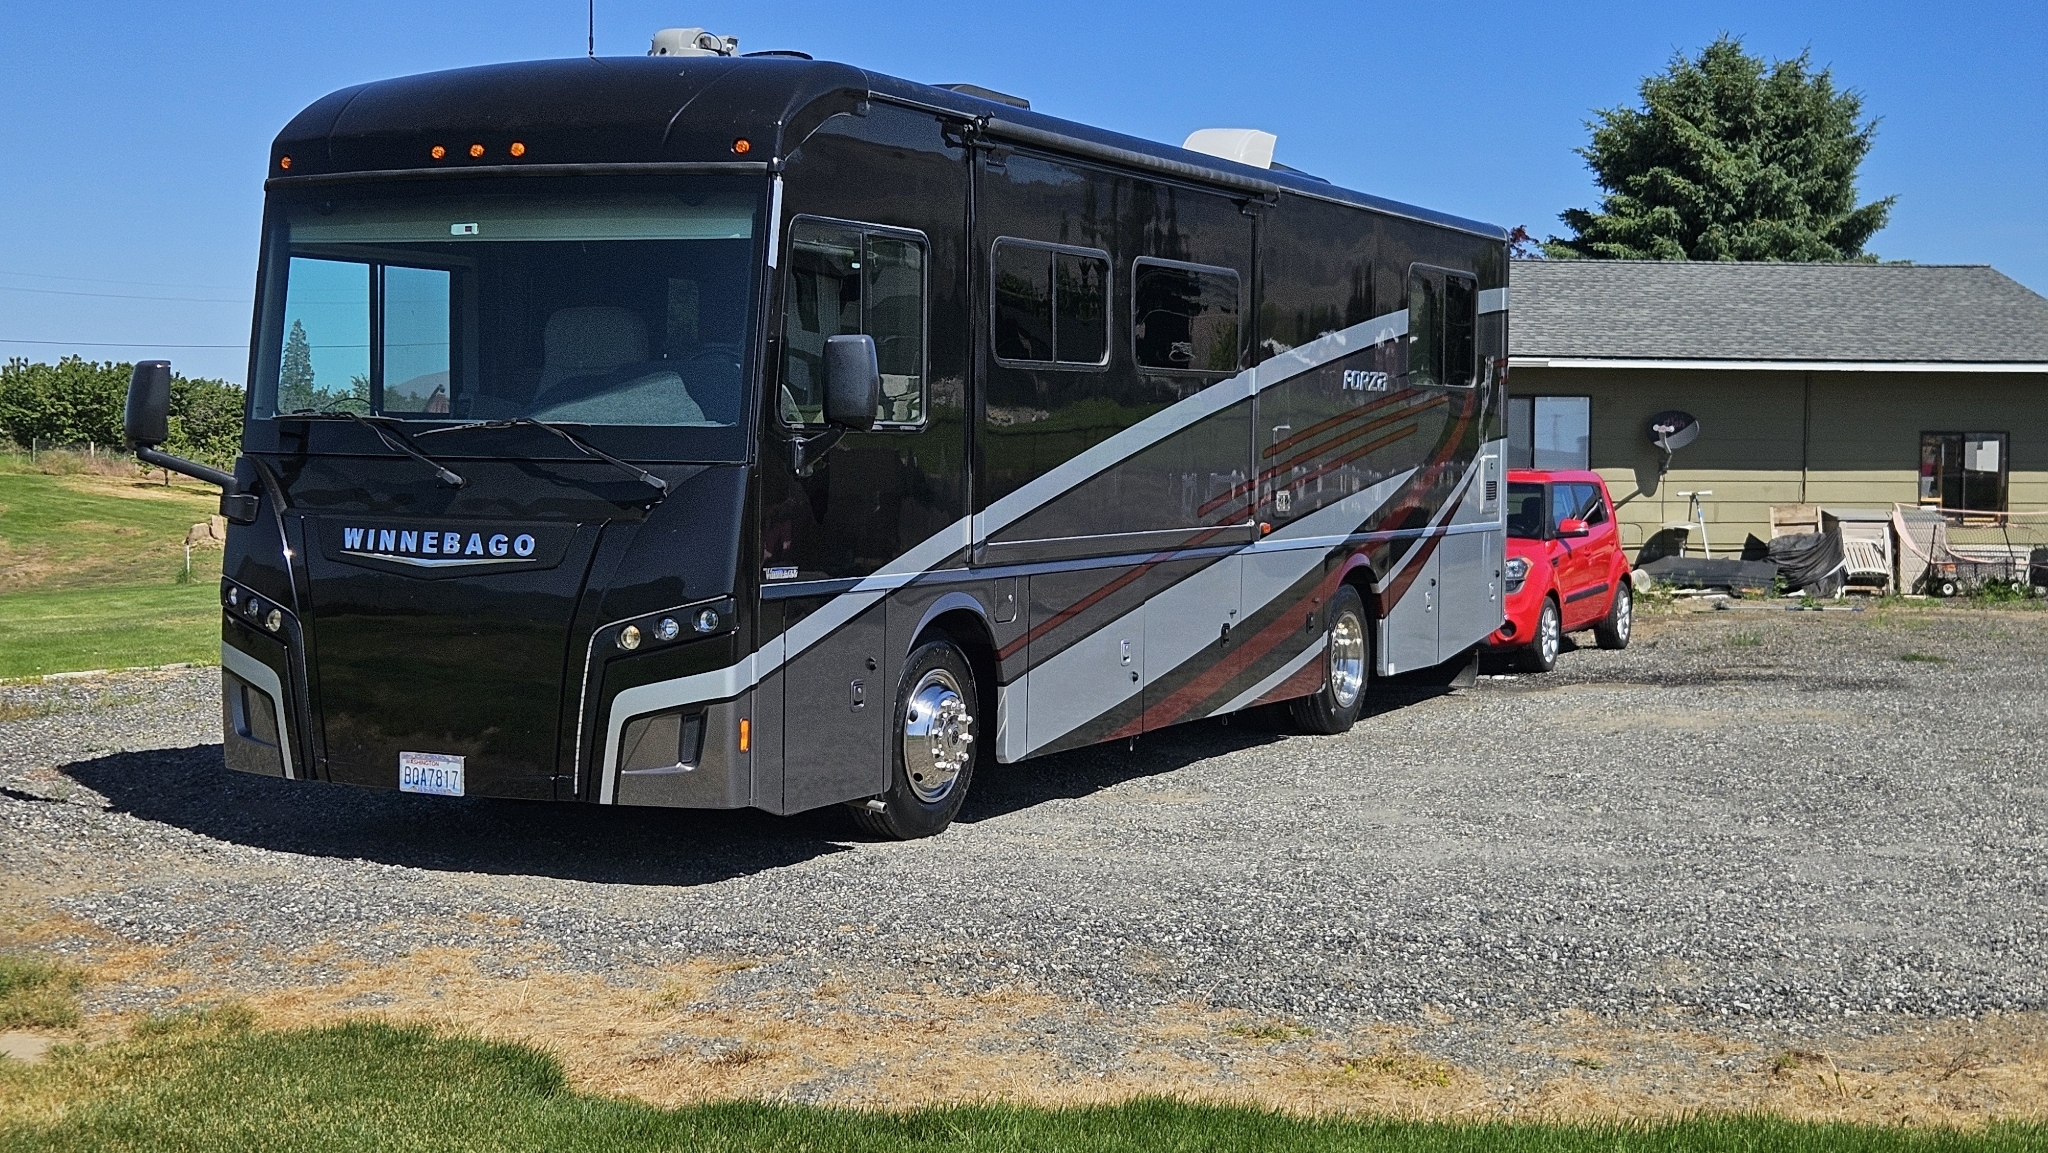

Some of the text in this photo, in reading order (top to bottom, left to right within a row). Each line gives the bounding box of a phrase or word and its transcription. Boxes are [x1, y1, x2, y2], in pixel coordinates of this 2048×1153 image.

[344, 527, 535, 557] WINNEBAGO
[405, 759, 440, 767] WASHINGTON
[404, 766, 459, 790] BQA7817
